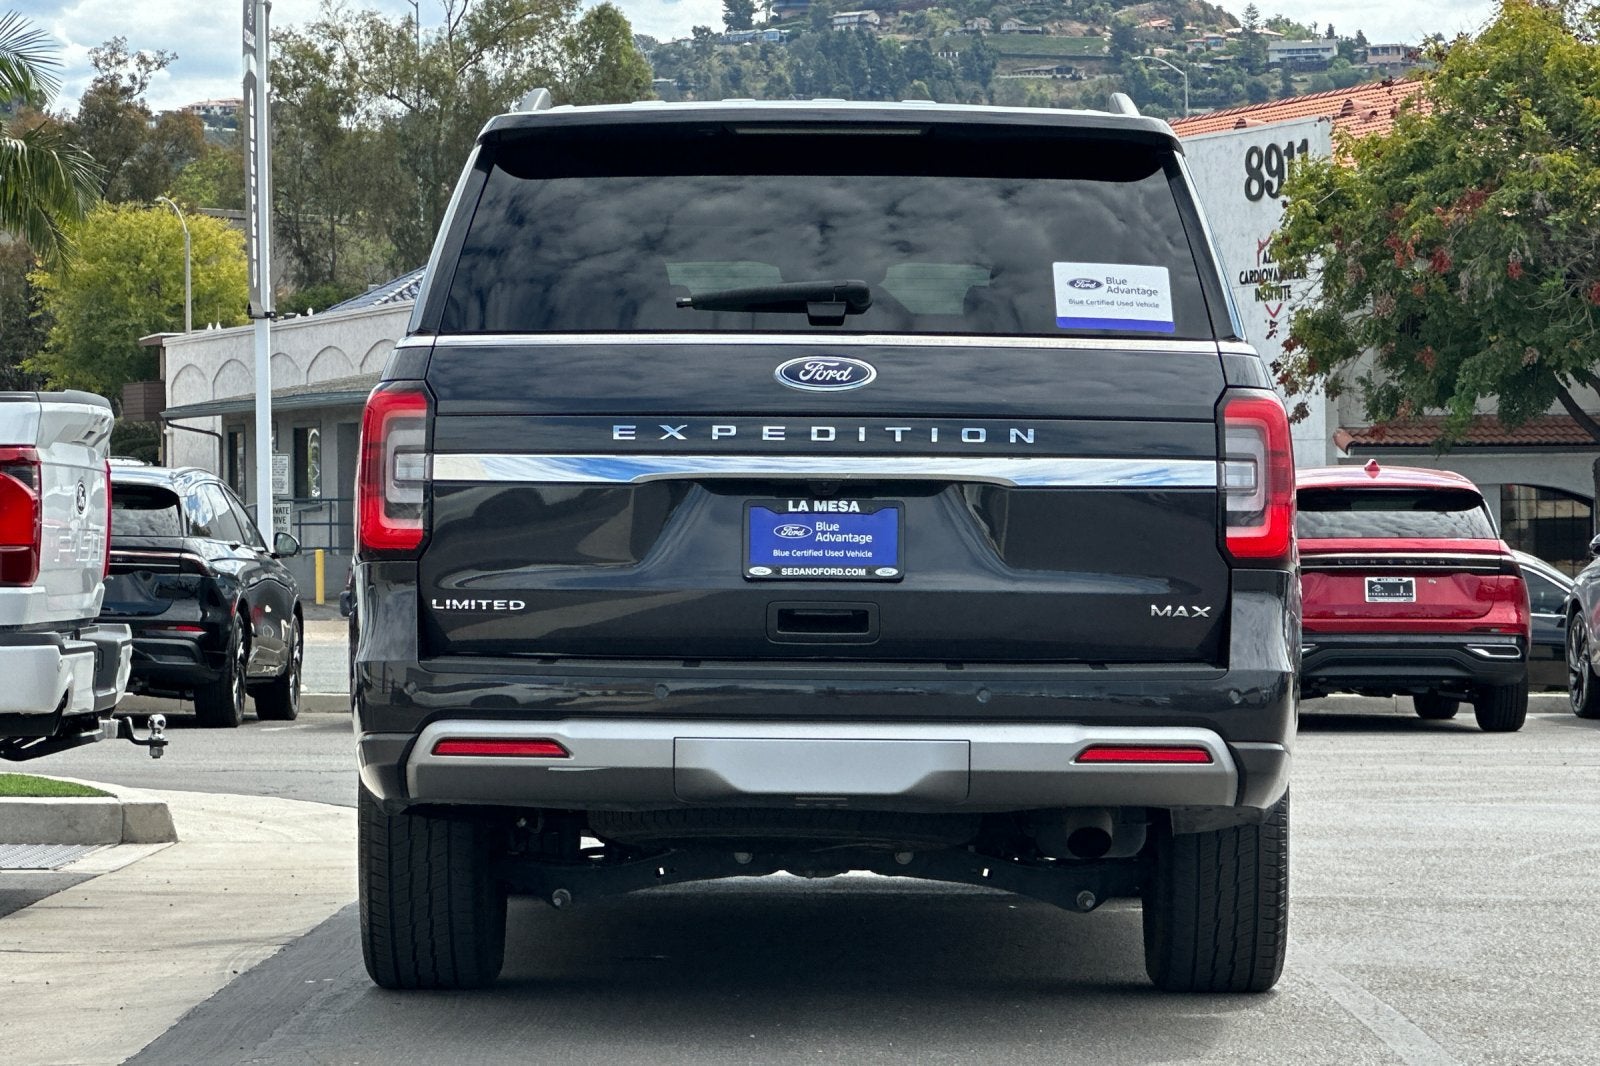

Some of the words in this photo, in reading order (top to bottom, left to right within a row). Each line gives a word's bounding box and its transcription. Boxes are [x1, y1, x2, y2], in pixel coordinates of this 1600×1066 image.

[1244, 138, 1309, 202] 89
[1105, 276, 1128, 286] Blue
[1106, 286, 1159, 297] Advantage
[1085, 299, 1115, 307] Certified
[1135, 301, 1160, 309] Vehicle
[612, 424, 1035, 444] EXPEDITION
[273, 506, 290, 515] IVATE
[788, 500, 809, 512] LA
[813, 500, 861, 513] MESA
[815, 521, 840, 531] Blue
[815, 532, 873, 544] Advantage
[773, 549, 790, 557] Blue
[791, 549, 823, 557] Certified
[825, 549, 844, 557] Used
[845, 550, 873, 558] Vehicle
[781, 568, 866, 576] SEDANOFORD.COM
[431, 599, 526, 611] LIMITED
[1150, 604, 1212, 618] MAX
